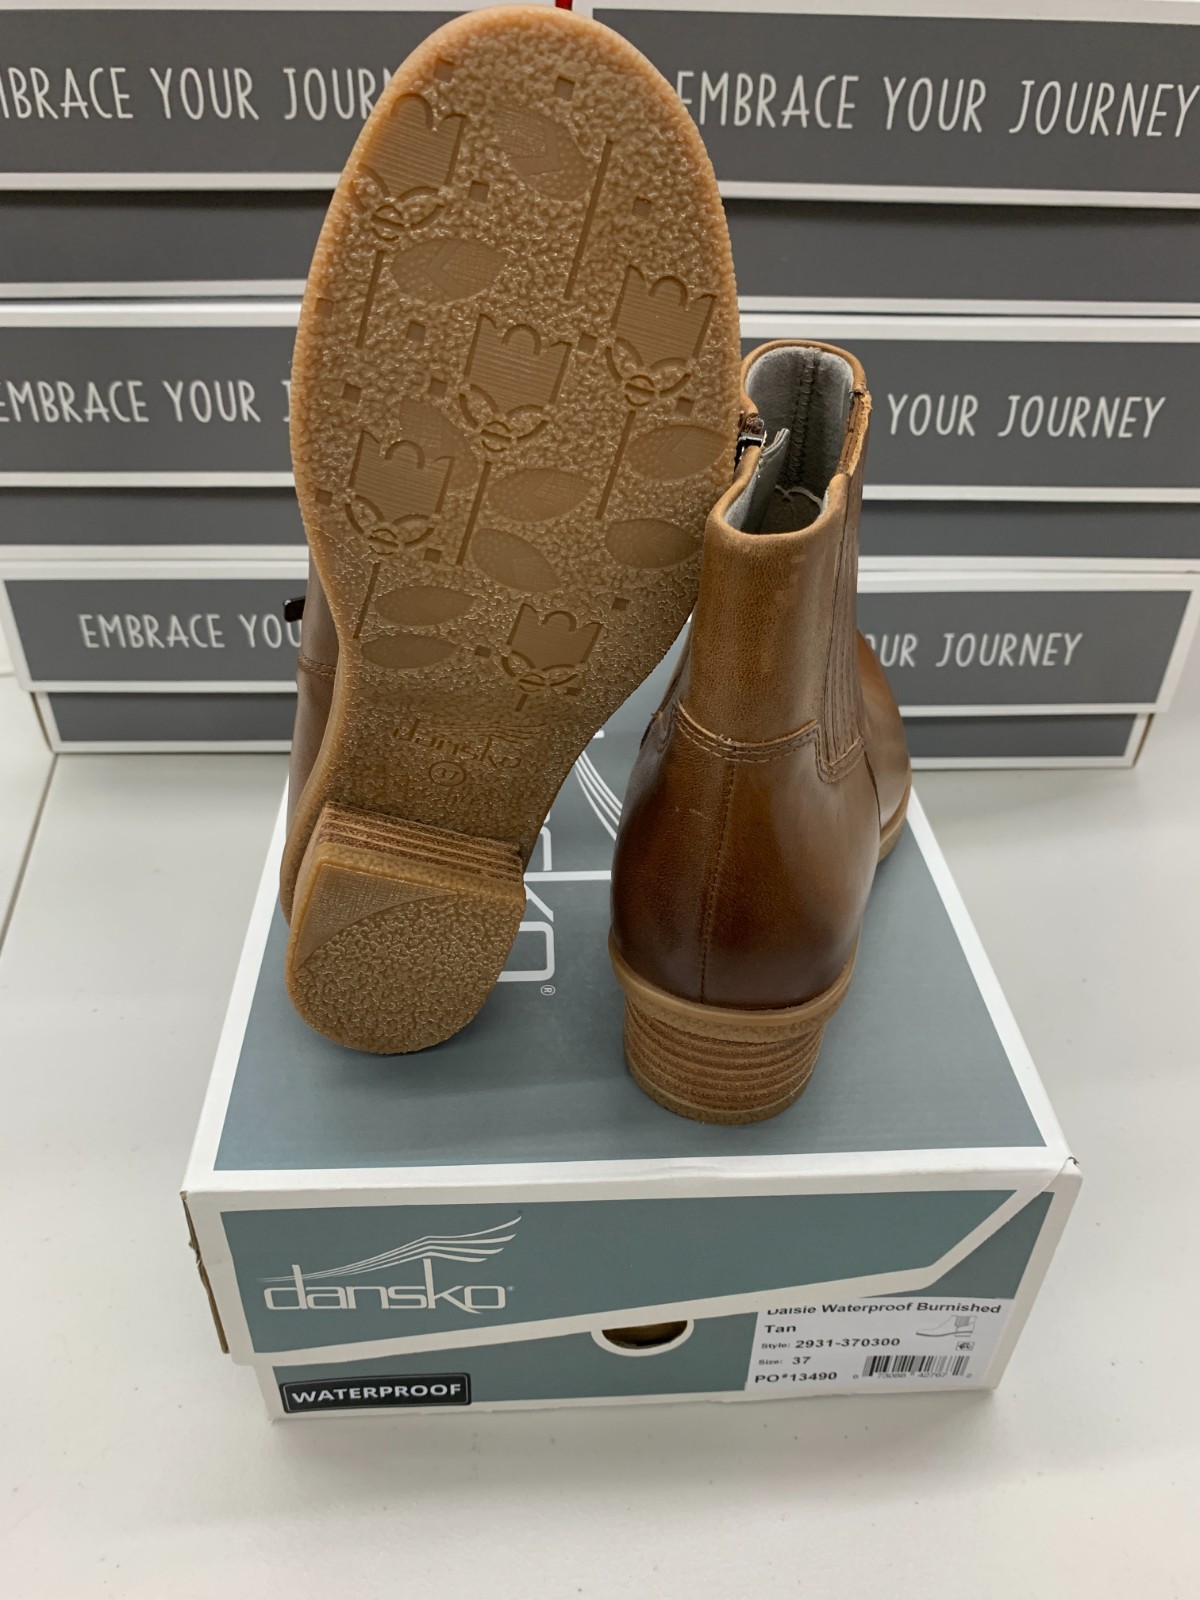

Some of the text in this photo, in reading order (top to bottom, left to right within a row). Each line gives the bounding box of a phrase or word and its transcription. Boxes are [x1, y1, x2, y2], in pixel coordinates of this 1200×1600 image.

[0, 67, 392, 121] BRACE YOUR JOUR
[884, 77, 987, 133] YOUR
[1009, 80, 1200, 138] JOURNEY
[163, 380, 261, 423] YOUR
[888, 394, 1166, 439] YOUR JOURNEY
[79, 614, 302, 649] EMBRACE YOU
[865, 633, 1083, 668] UR JOURNEY
[263, 1257, 506, 1315] dansko
[822, 1302, 913, 1315] Waterproof
[916, 1302, 1001, 1314] Burnished
[761, 1338, 900, 1350] Style: 2931-370300
[764, 1324, 797, 1334] Tan
[792, 1356, 811, 1365] 37
[292, 1383, 462, 1404] WATERPROOF
